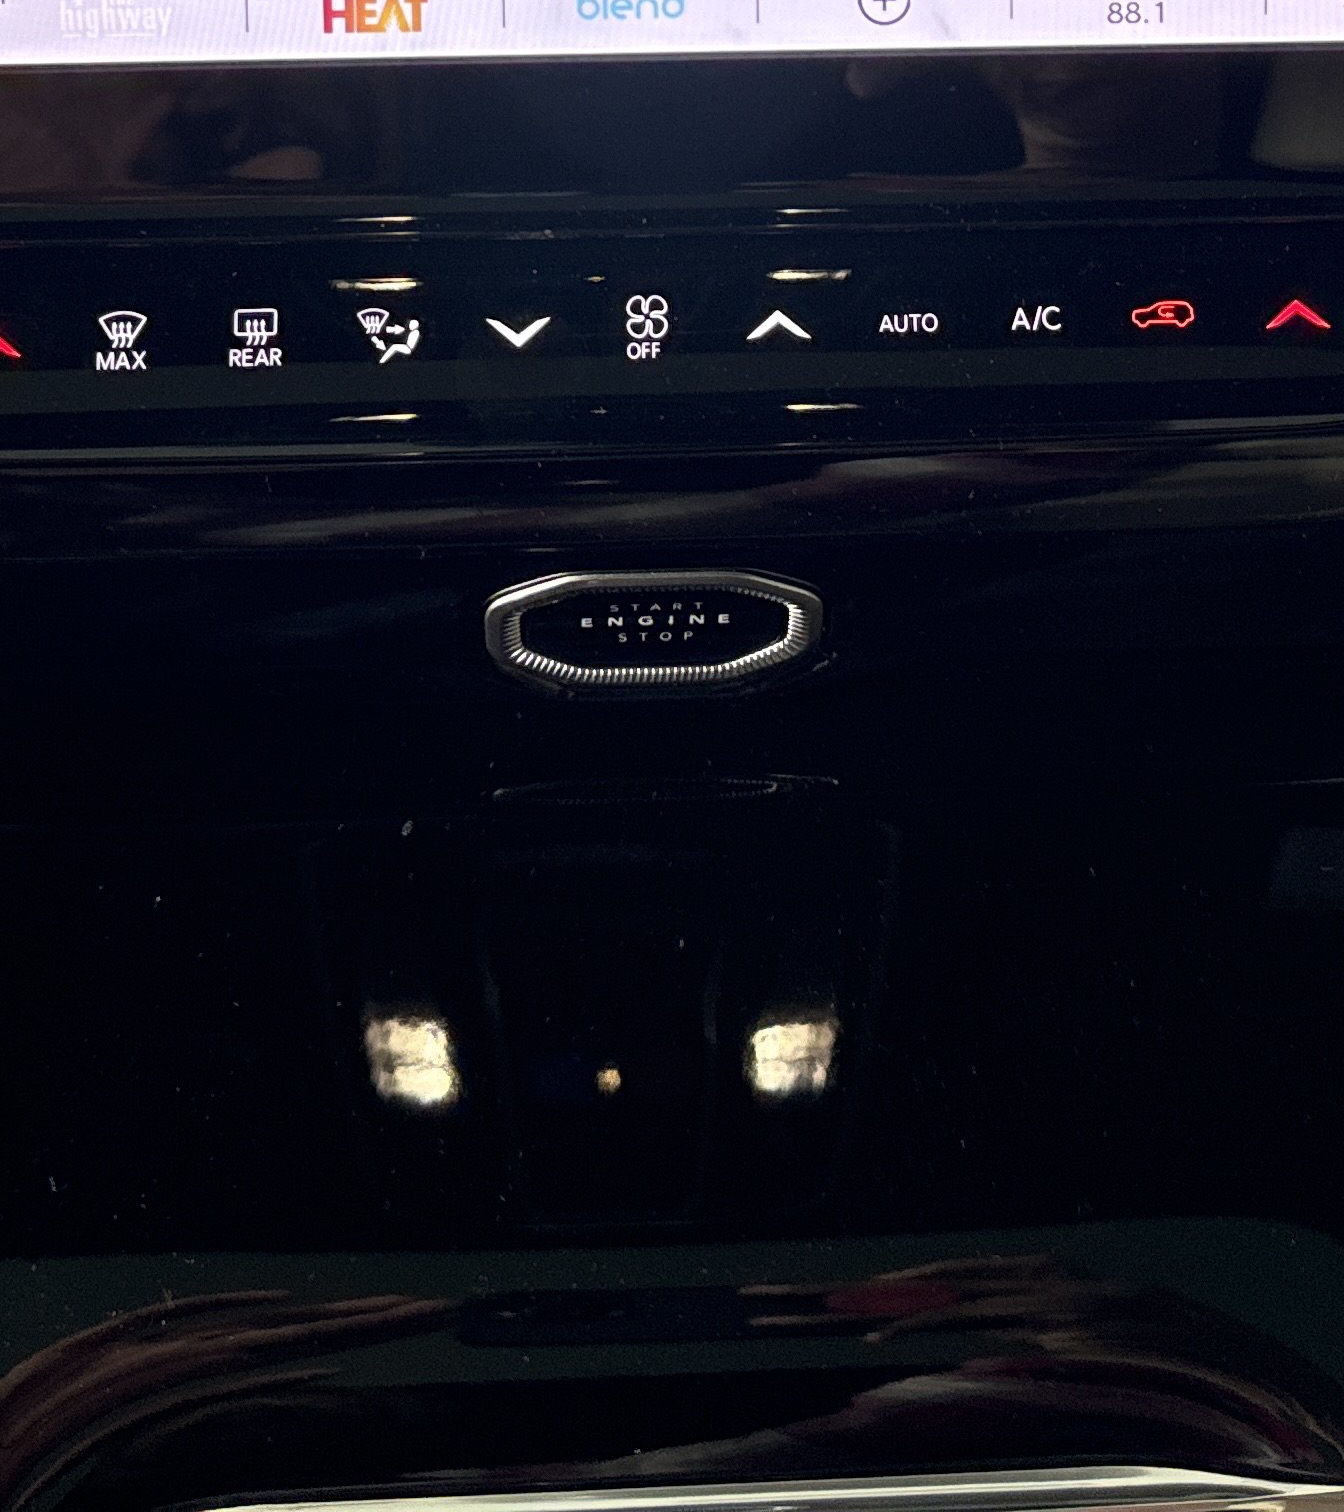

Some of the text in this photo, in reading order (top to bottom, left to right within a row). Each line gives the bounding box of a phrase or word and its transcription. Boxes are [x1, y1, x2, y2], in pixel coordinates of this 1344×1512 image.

[1107, 1, 1166, 25] 88.1
[879, 314, 938, 333] AUTO
[1012, 306, 1061, 332] A/C
[229, 349, 281, 368] REAR
[626, 342, 661, 359] OFF
[96, 351, 147, 370] MAX
[609, 601, 703, 612] START
[580, 613, 731, 628] ENGINE
[617, 630, 694, 643] STOP
